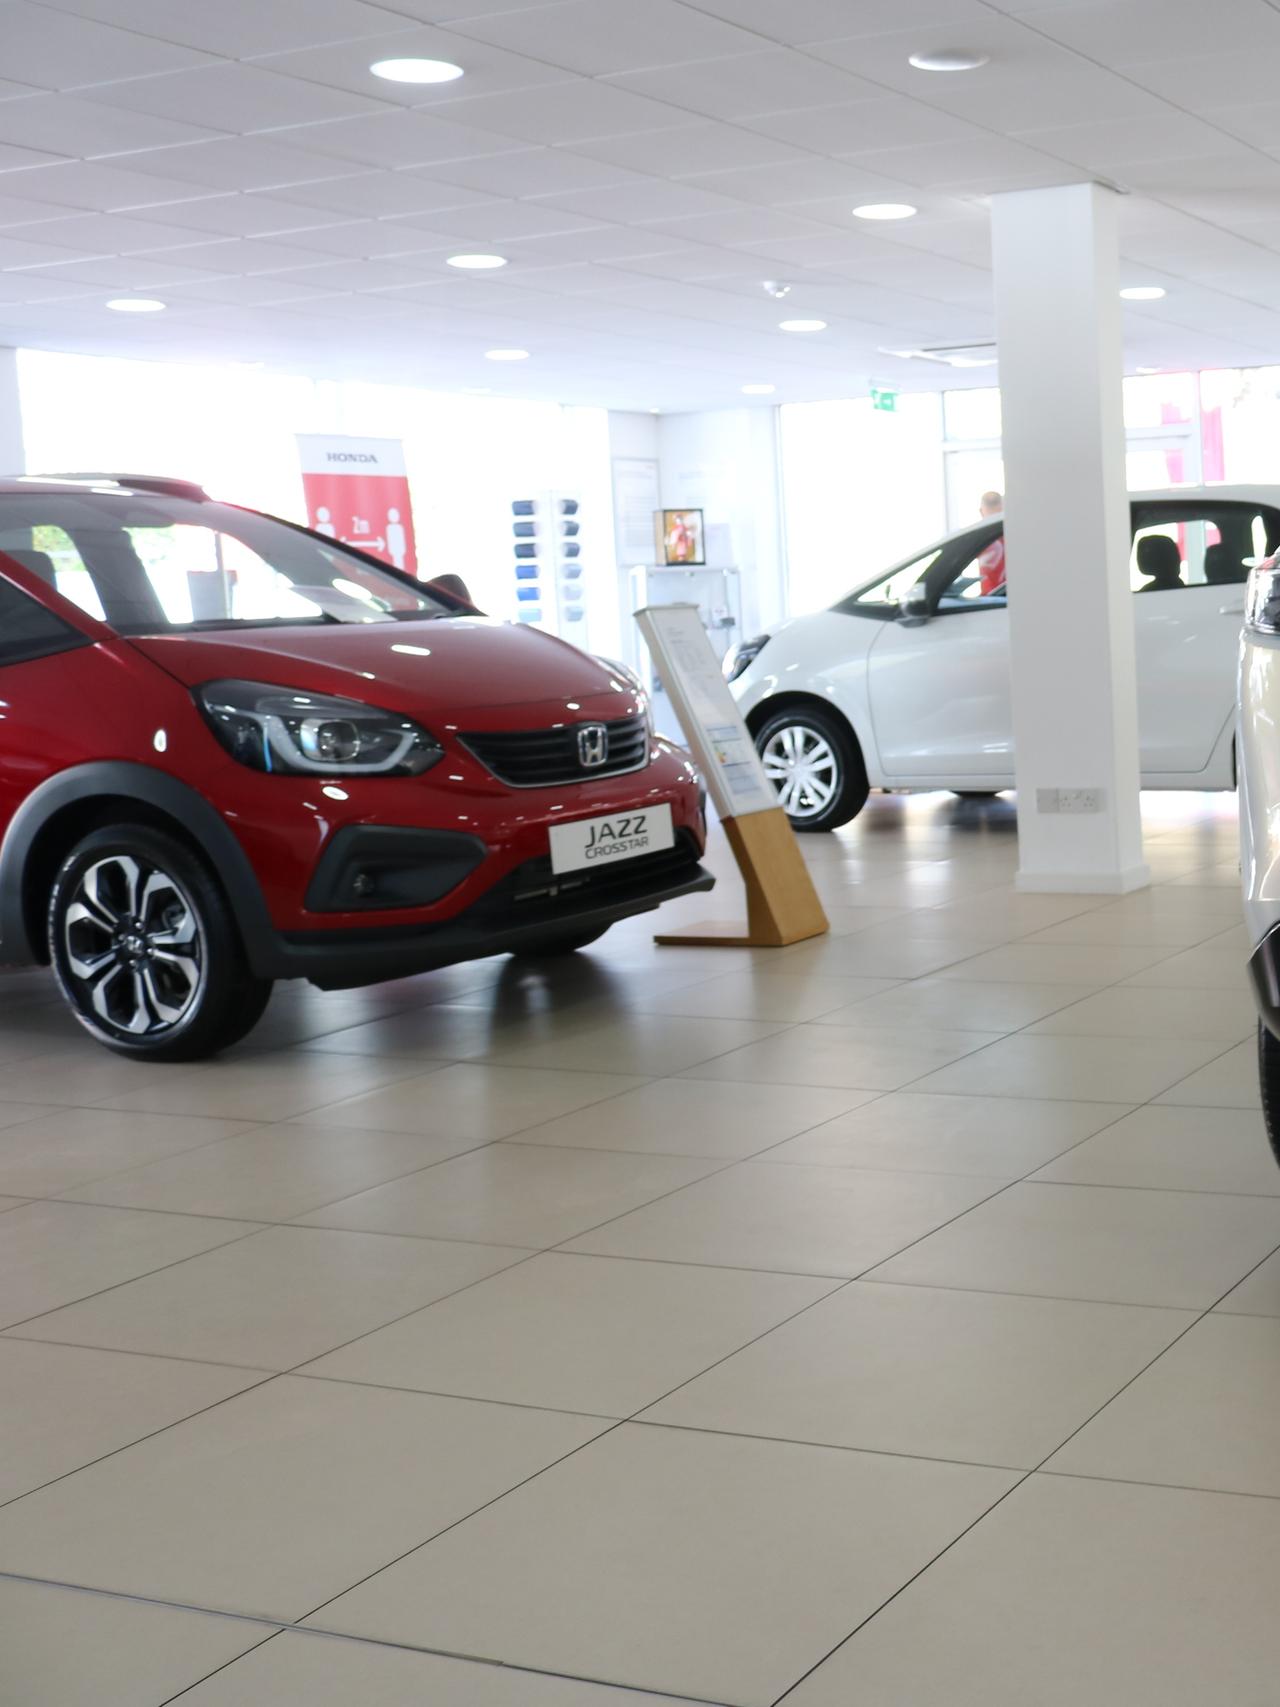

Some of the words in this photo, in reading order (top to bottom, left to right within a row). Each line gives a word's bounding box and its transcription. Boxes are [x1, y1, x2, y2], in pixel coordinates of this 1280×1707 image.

[326, 452, 378, 463] HONDA
[585, 815, 648, 848] JAZZ
[585, 836, 649, 859] CROSSTAR
